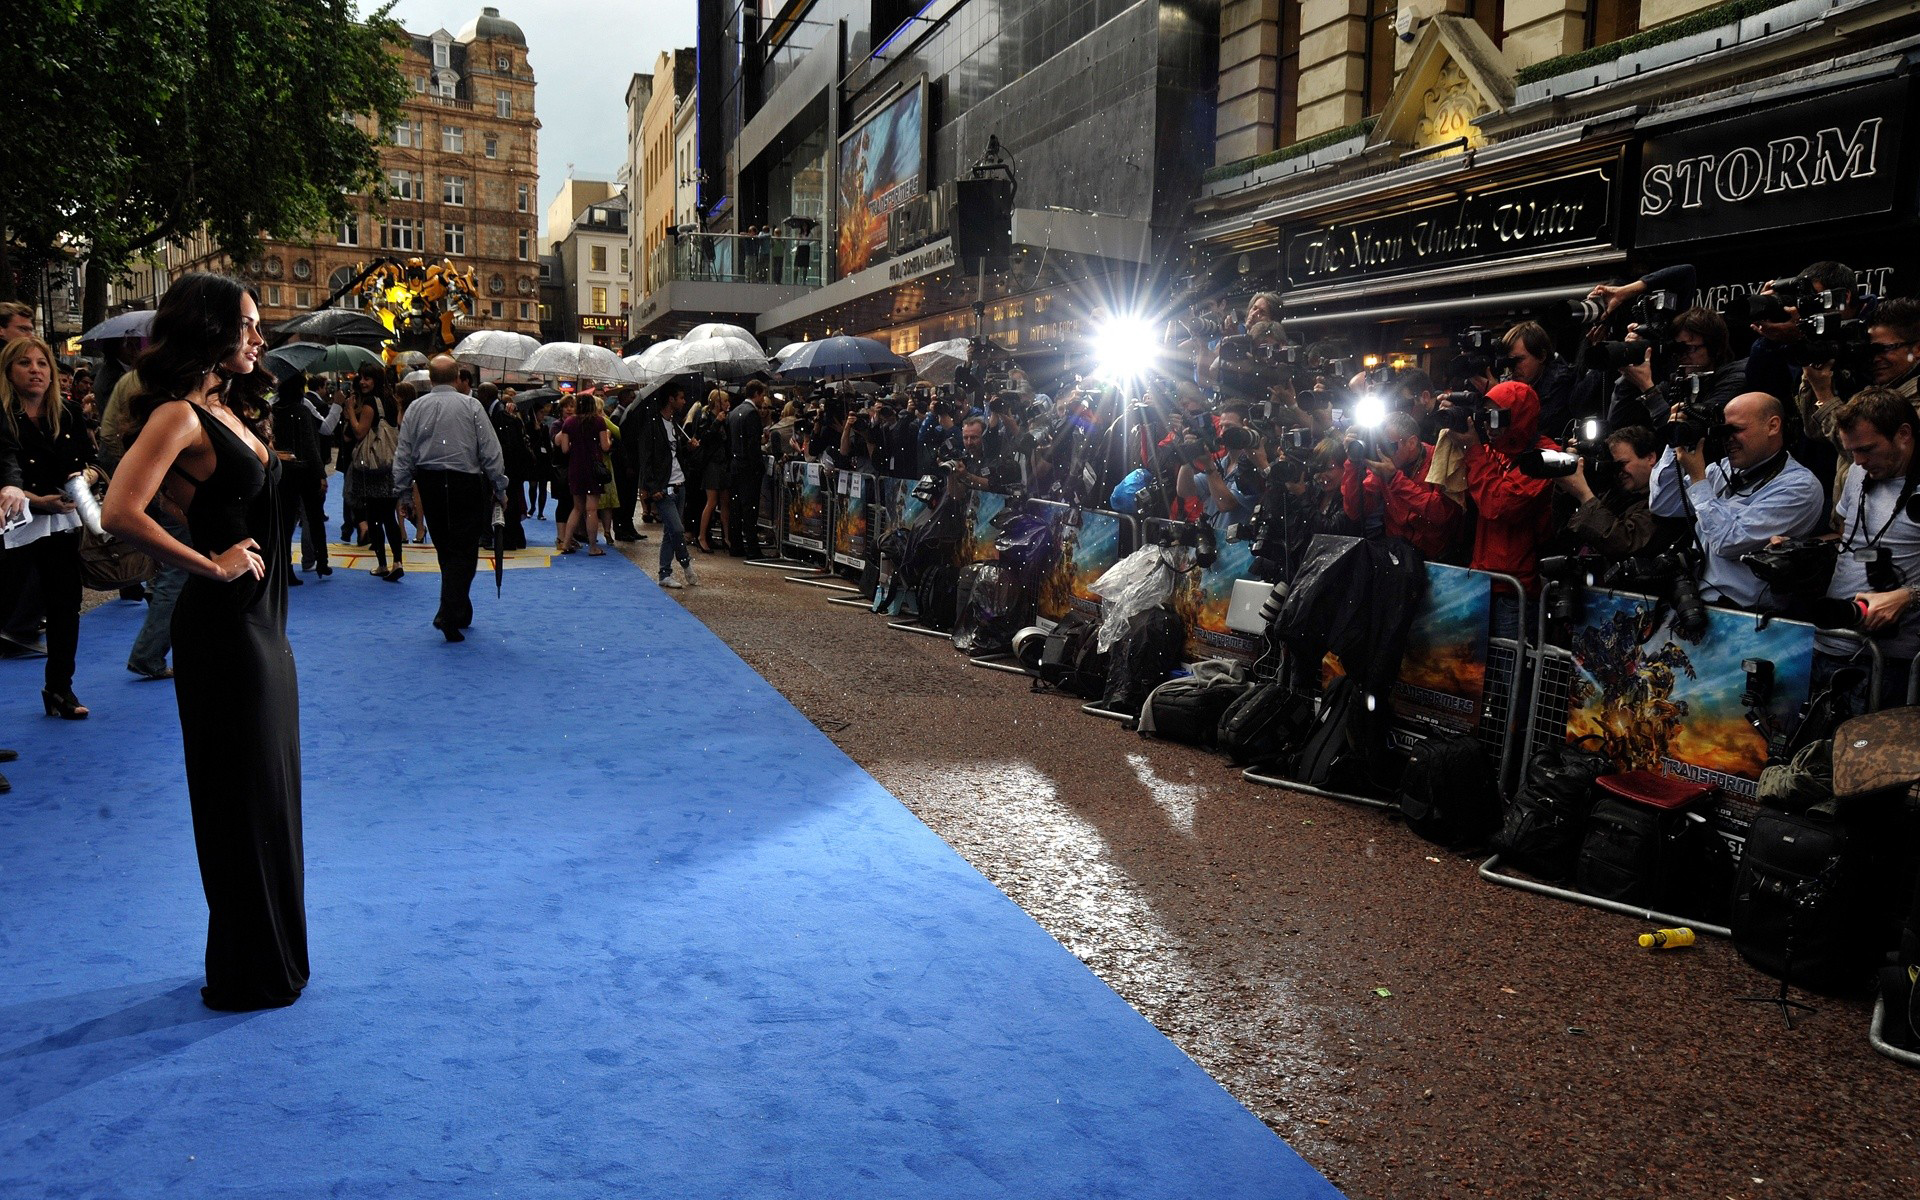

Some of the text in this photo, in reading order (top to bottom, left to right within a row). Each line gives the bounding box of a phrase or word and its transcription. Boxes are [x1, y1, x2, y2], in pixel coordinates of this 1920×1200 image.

[1640, 117, 1883, 215] STORM
[1304, 196, 1584, 275] The Moon Under Water
[583, 317, 611, 326] BELLA
